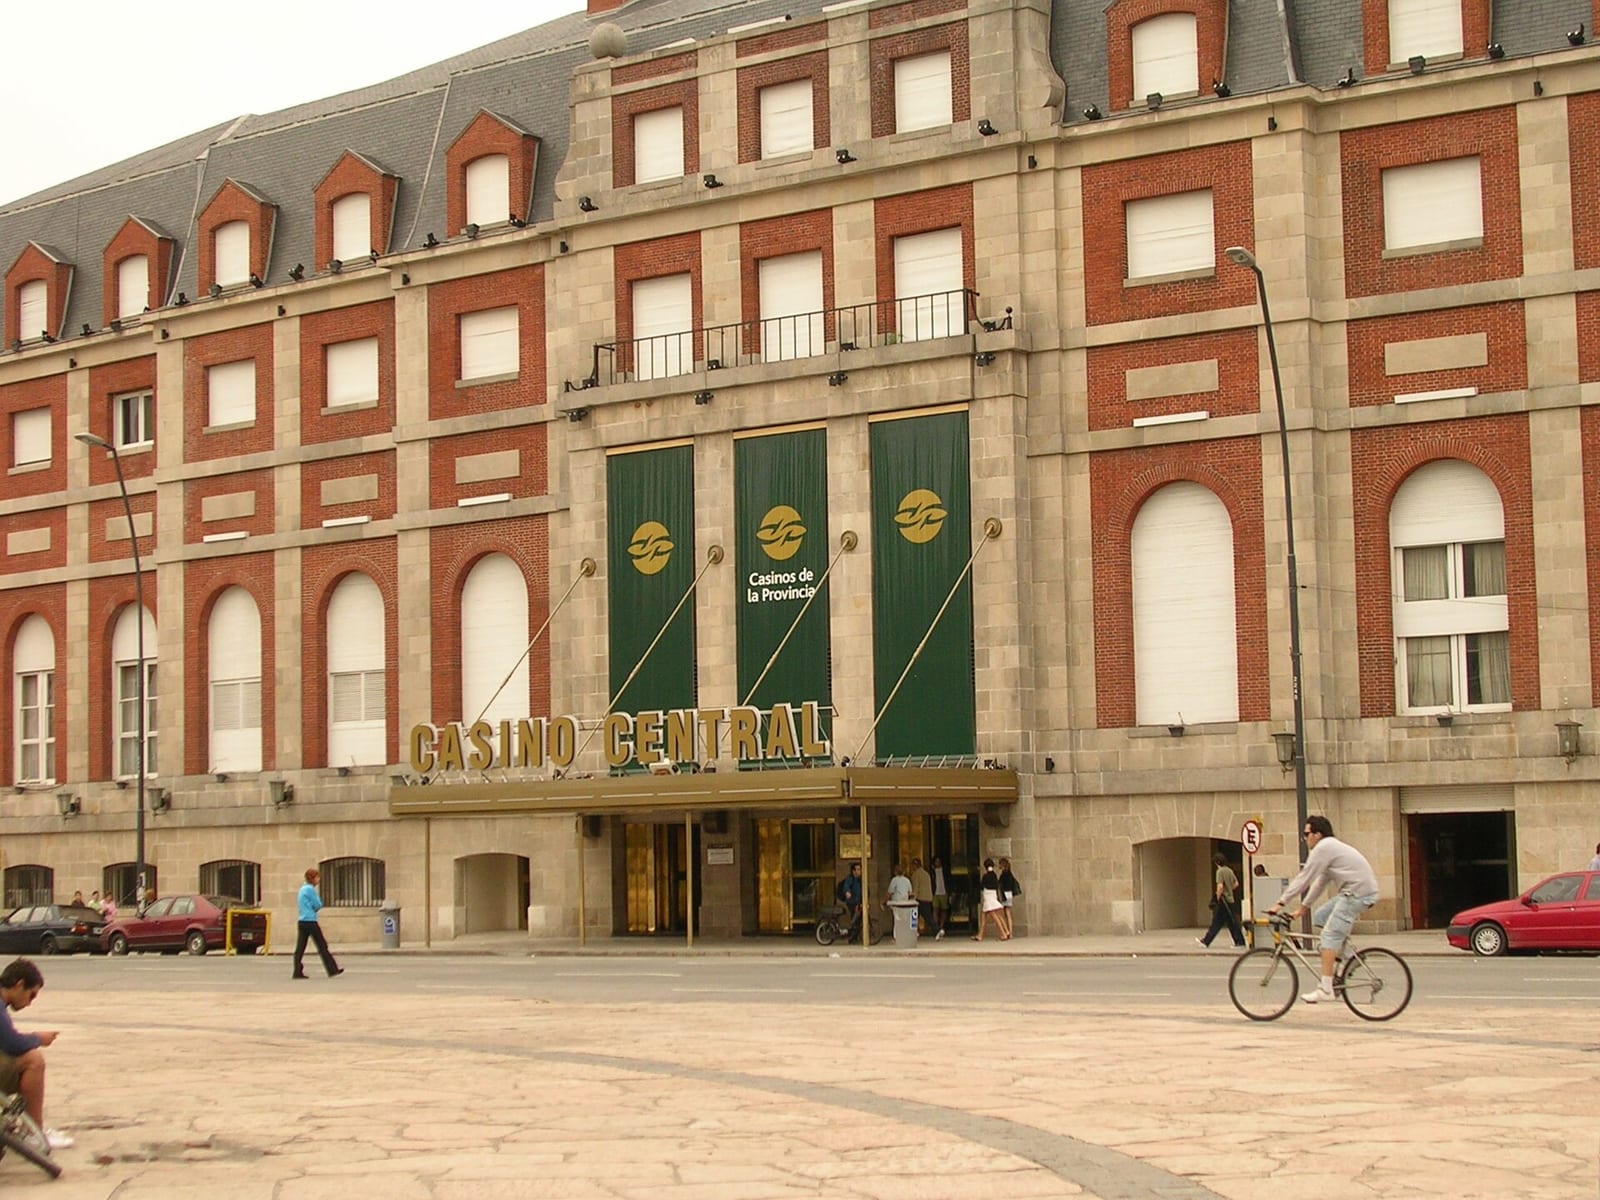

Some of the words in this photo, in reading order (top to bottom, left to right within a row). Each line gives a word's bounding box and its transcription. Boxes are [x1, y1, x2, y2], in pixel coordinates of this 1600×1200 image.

[749, 571, 796, 586] Casinos
[799, 567, 813, 581] de
[747, 588, 758, 603] la
[762, 584, 815, 601] Provincia
[410, 715, 579, 774] CASINO
[604, 701, 830, 767] CENTRAL
[1248, 829, 1256, 843] E
